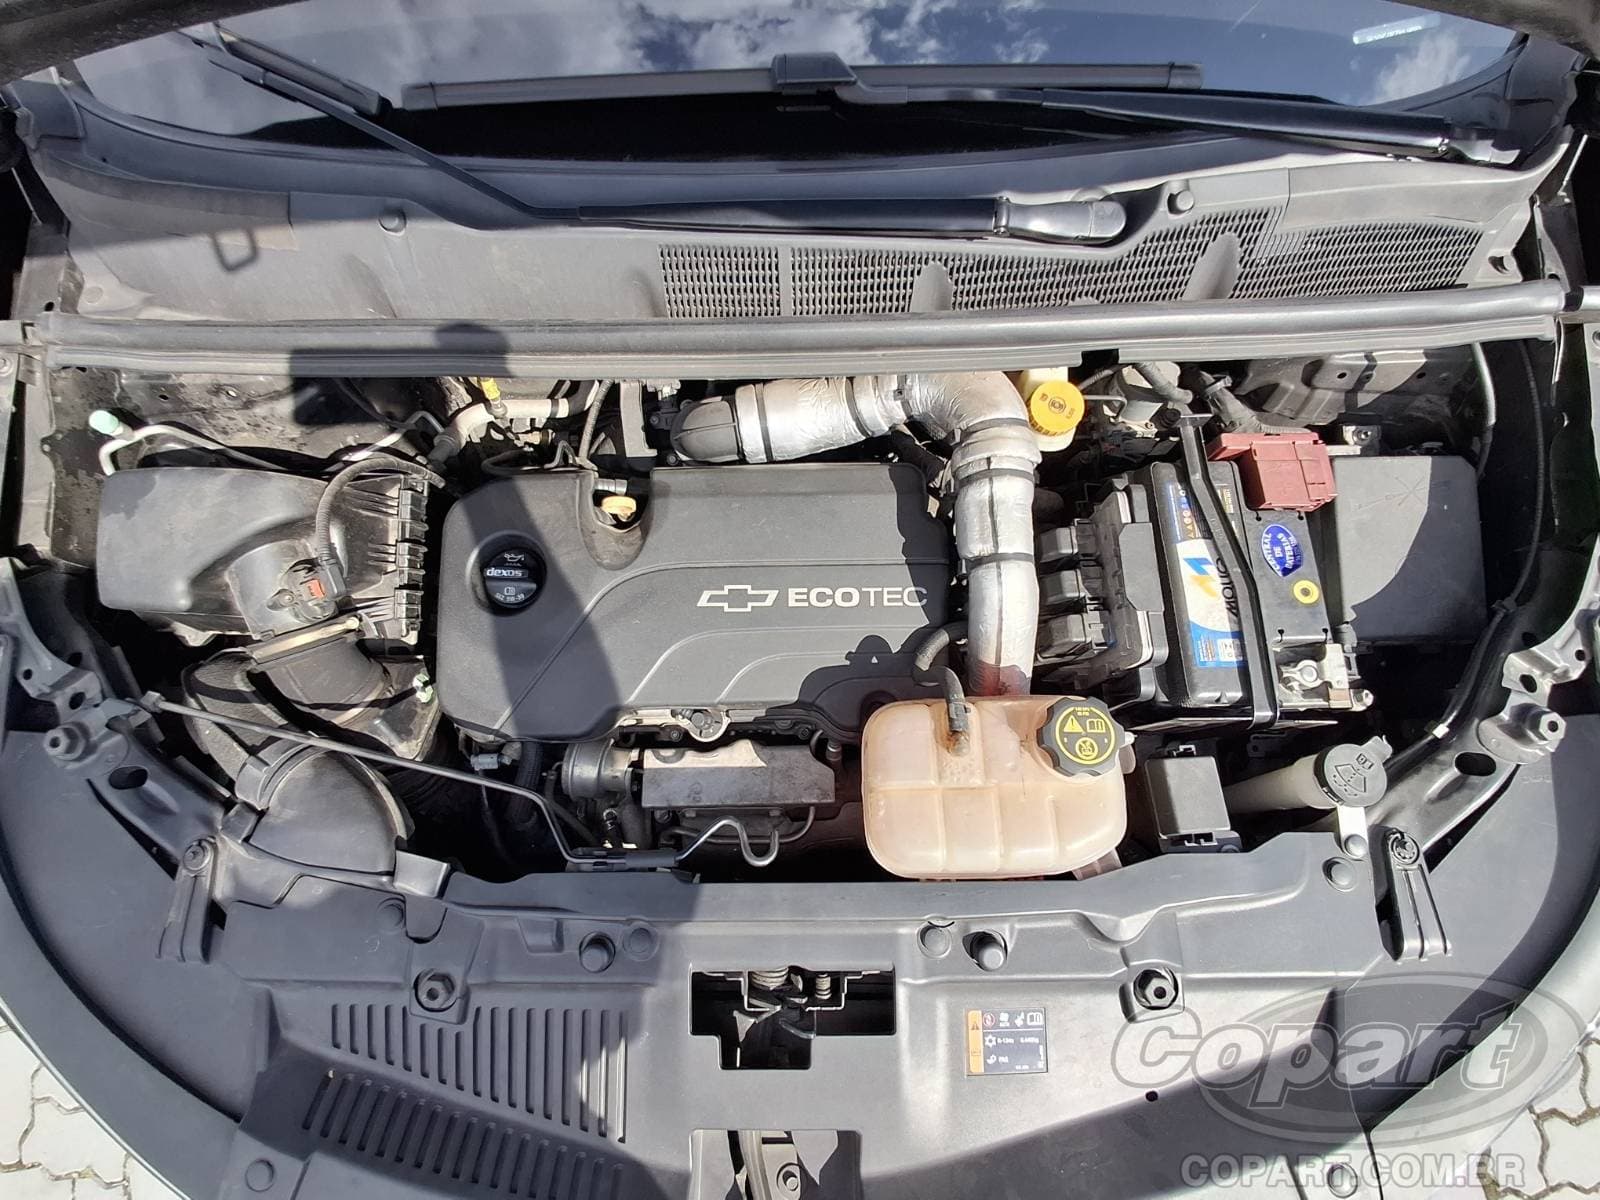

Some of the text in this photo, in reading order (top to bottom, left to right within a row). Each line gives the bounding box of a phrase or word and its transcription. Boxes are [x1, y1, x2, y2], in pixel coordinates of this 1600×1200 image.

[1262, 532, 1281, 573] CENTRAL
[486, 567, 523, 577] dexos
[787, 587, 928, 608] ECOTEC
